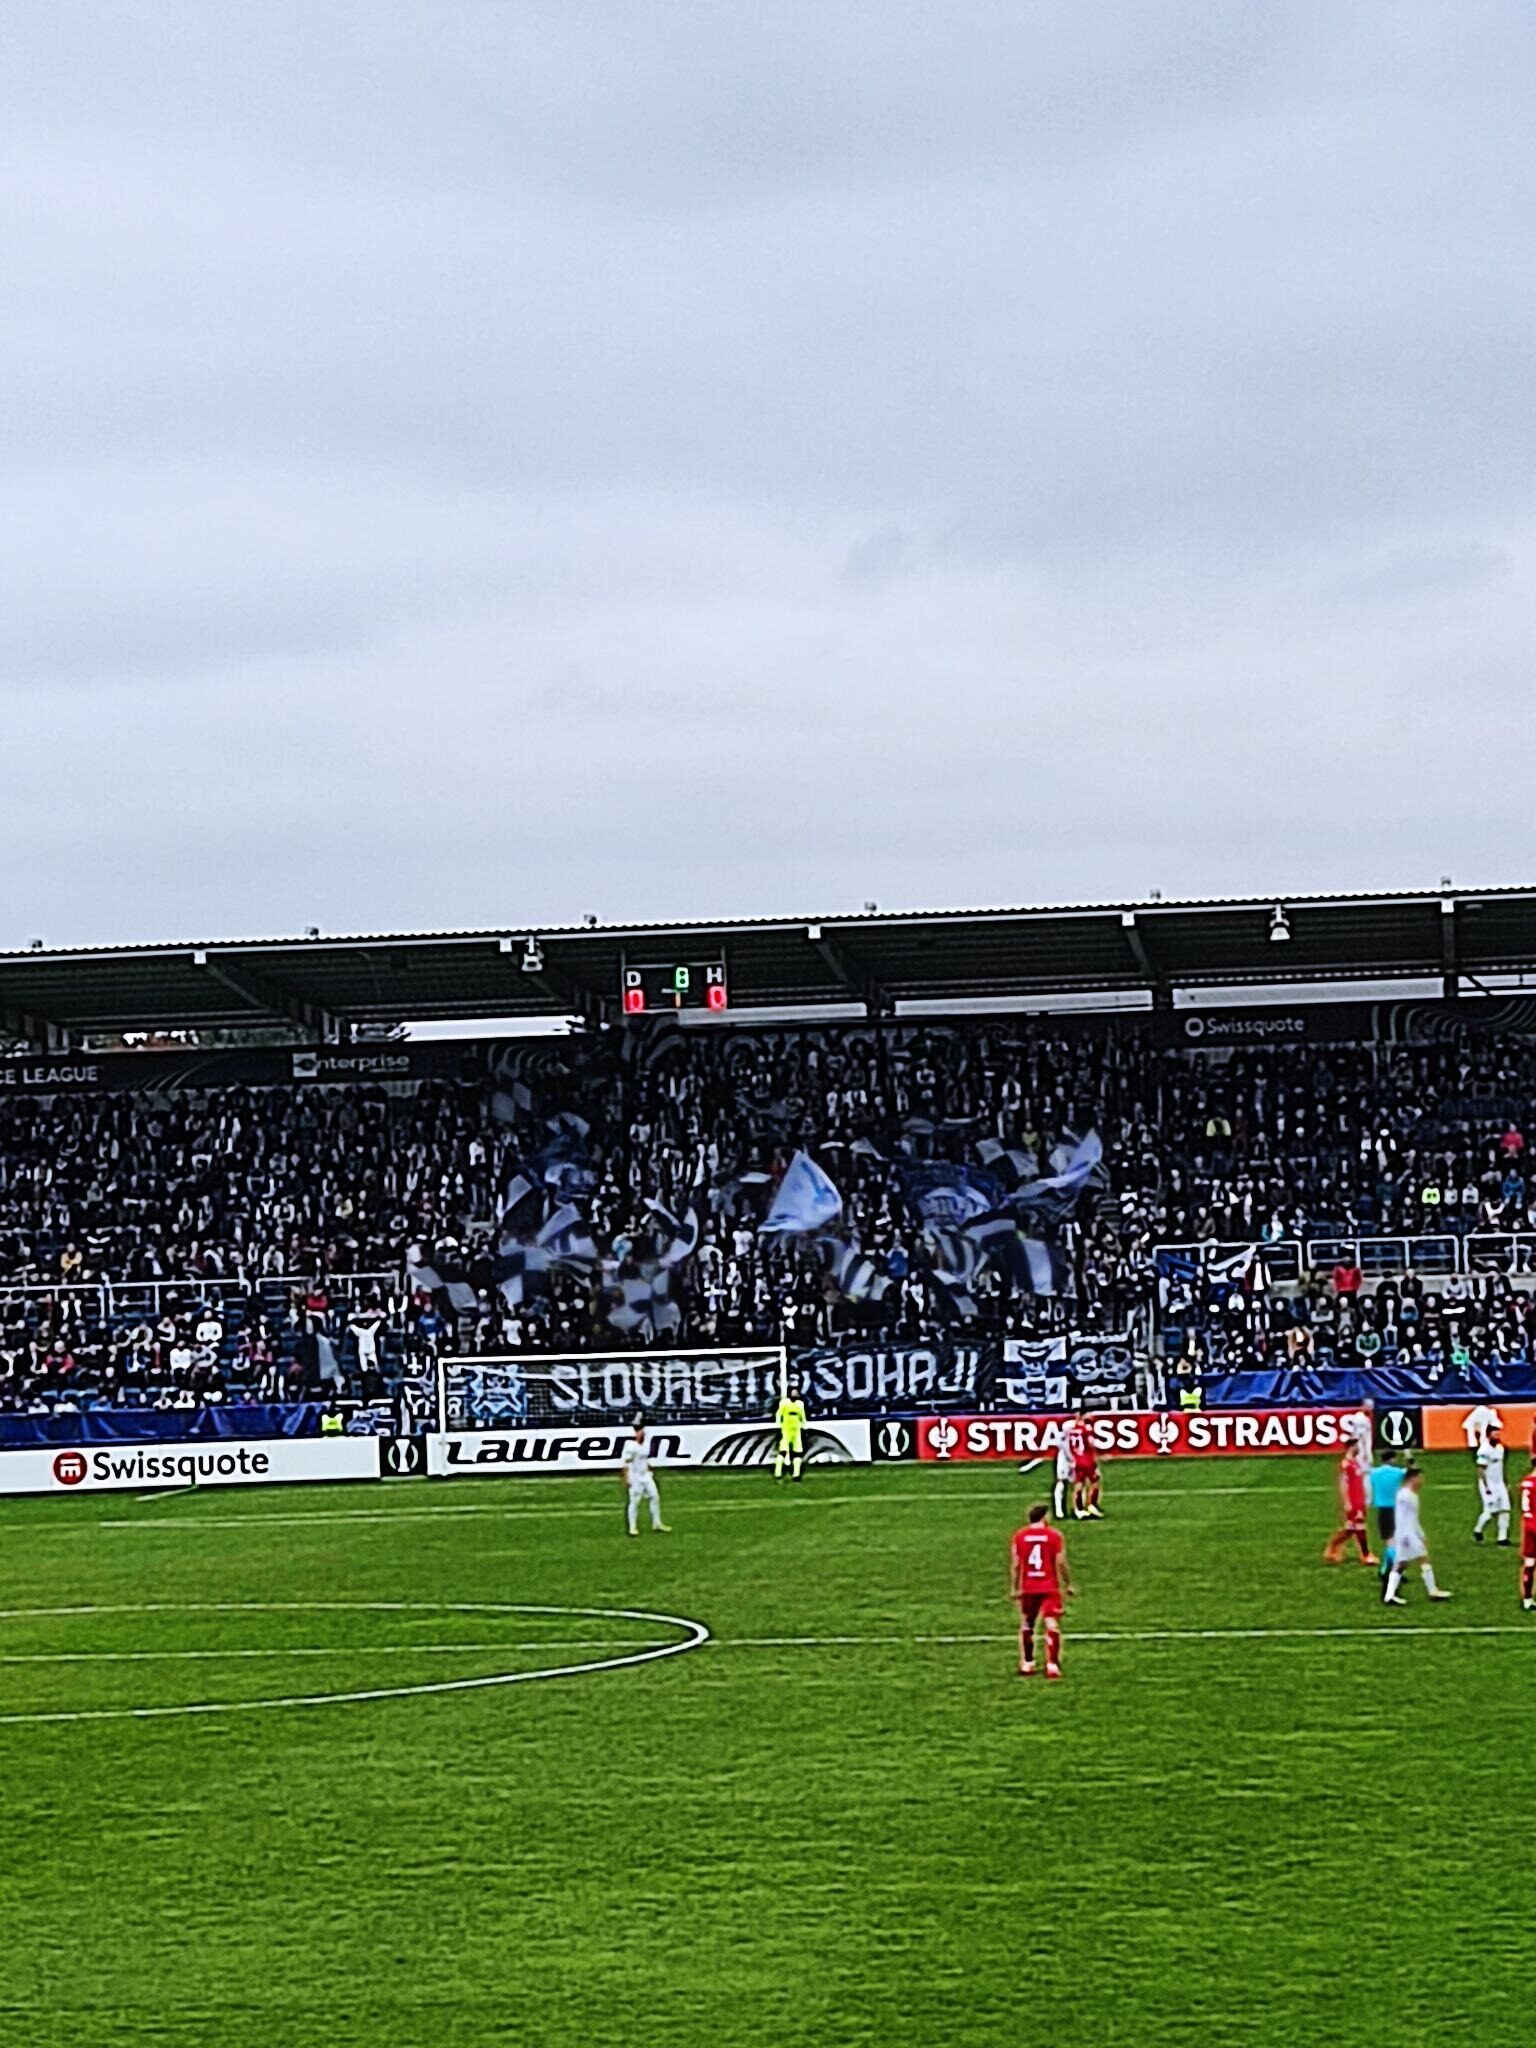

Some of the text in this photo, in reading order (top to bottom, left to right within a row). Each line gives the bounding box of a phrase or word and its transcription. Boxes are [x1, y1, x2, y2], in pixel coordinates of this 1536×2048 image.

[626, 970, 642, 987] D
[706, 967, 722, 984] H
[1206, 1017, 1304, 1037] Swissquote
[23, 1065, 99, 1084] LEAGUE
[967, 1419, 1139, 1452] STRASS
[1188, 1414, 1356, 1448] STRAUSS
[93, 1448, 269, 1485] Swissquote
[1028, 1543, 1043, 1570] 4
